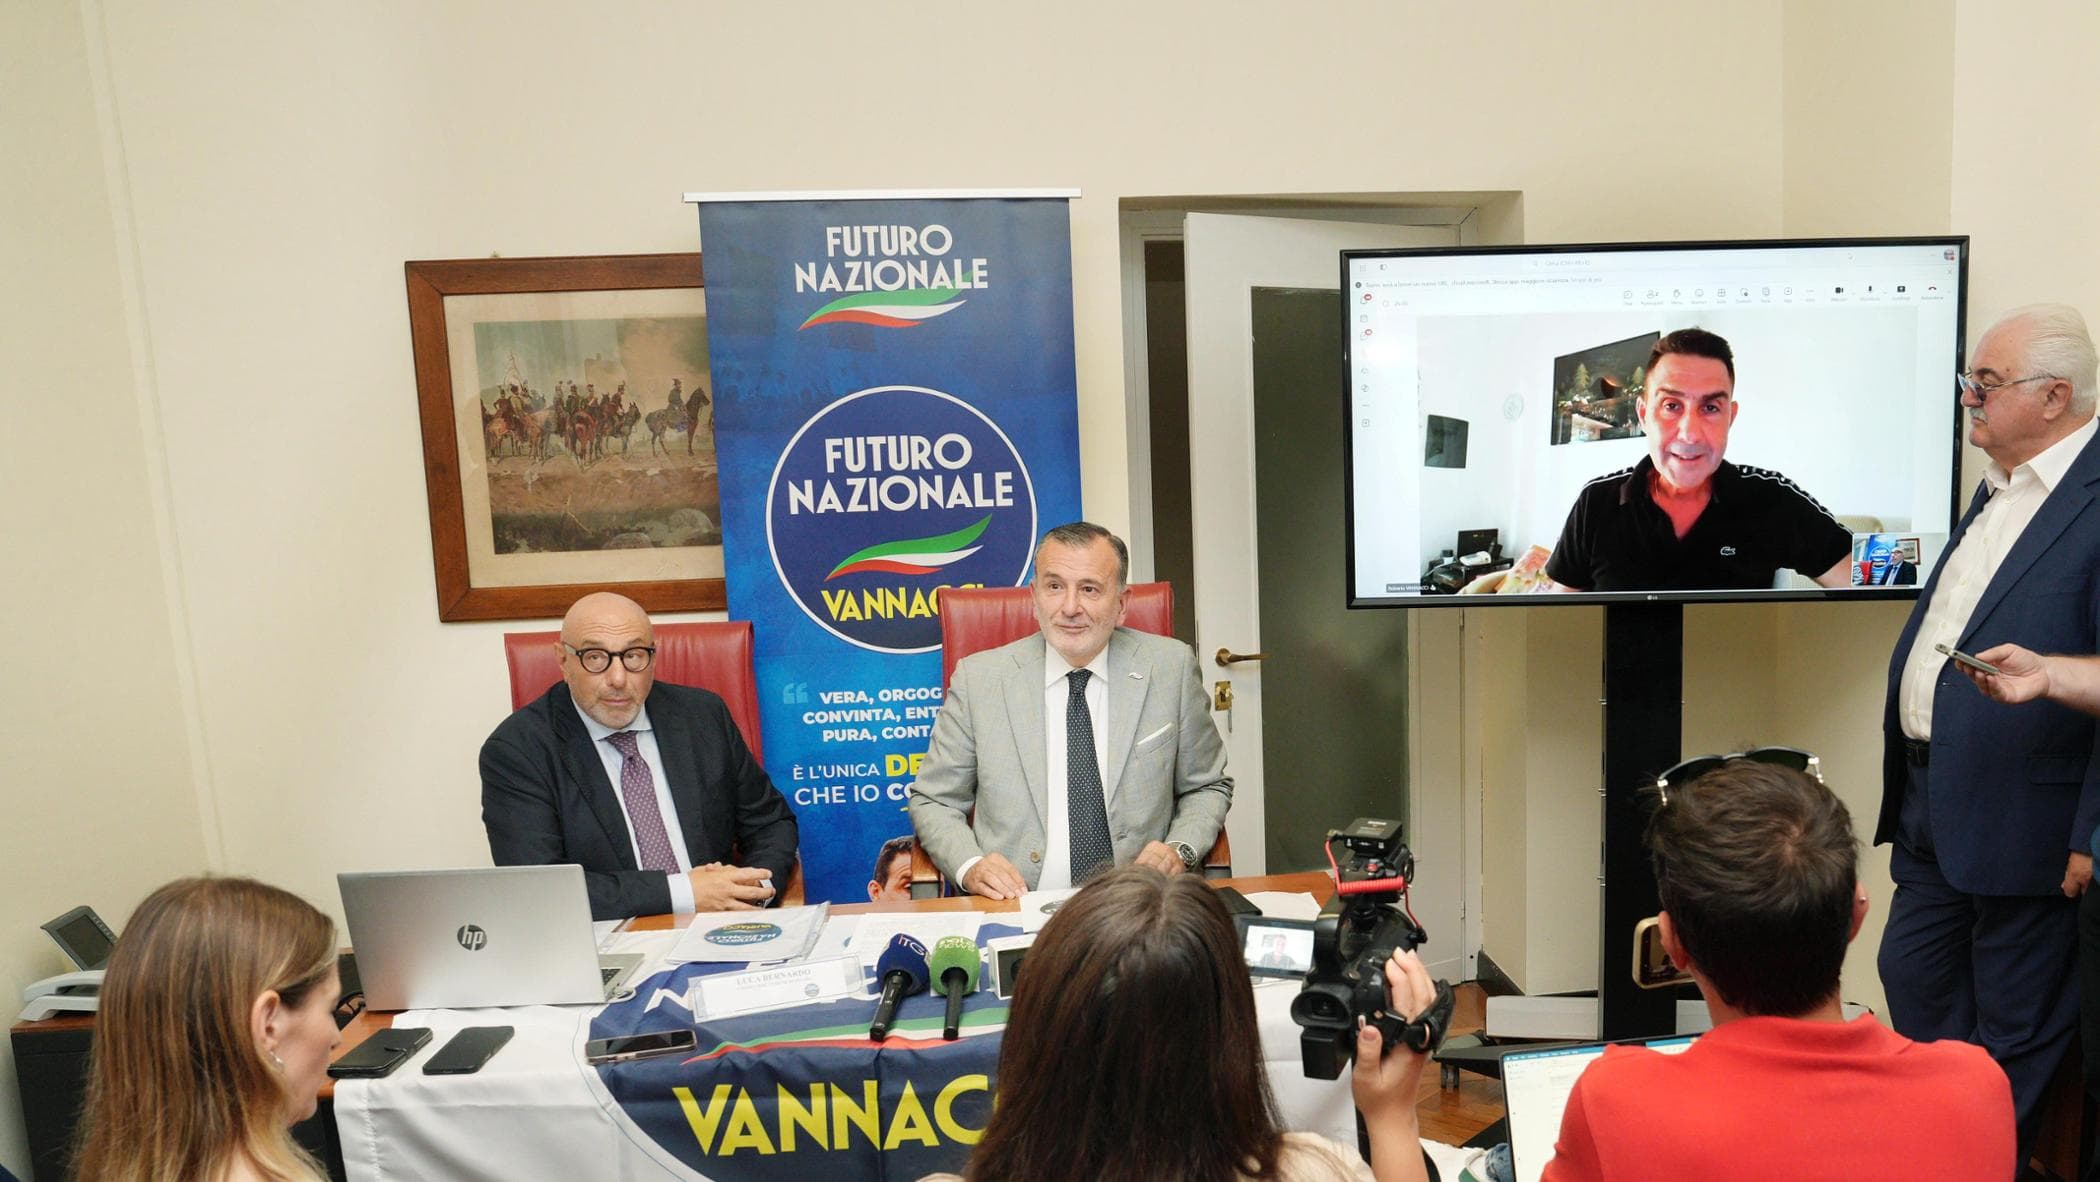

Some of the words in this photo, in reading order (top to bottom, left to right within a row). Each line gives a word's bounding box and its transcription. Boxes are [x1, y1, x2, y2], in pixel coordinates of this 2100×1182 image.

[825, 224, 953, 257] FUTURO
[794, 258, 989, 293] NAZIONALE
[824, 432, 973, 473] FUTURO
[788, 472, 1014, 515] NAZIONALE
[821, 583, 984, 621] VANNAC
[819, 690, 874, 705] VERA,
[802, 708, 902, 724] CONVINTA,
[905, 706, 944, 720] ENT
[822, 728, 878, 742] PURA,
[793, 764, 804, 781] È
[809, 763, 880, 779] L'UNICA
[794, 785, 847, 806] CHE
[853, 784, 880, 803] IO
[461, 924, 484, 951] hp
[672, 1074, 999, 1157] VANNAC
